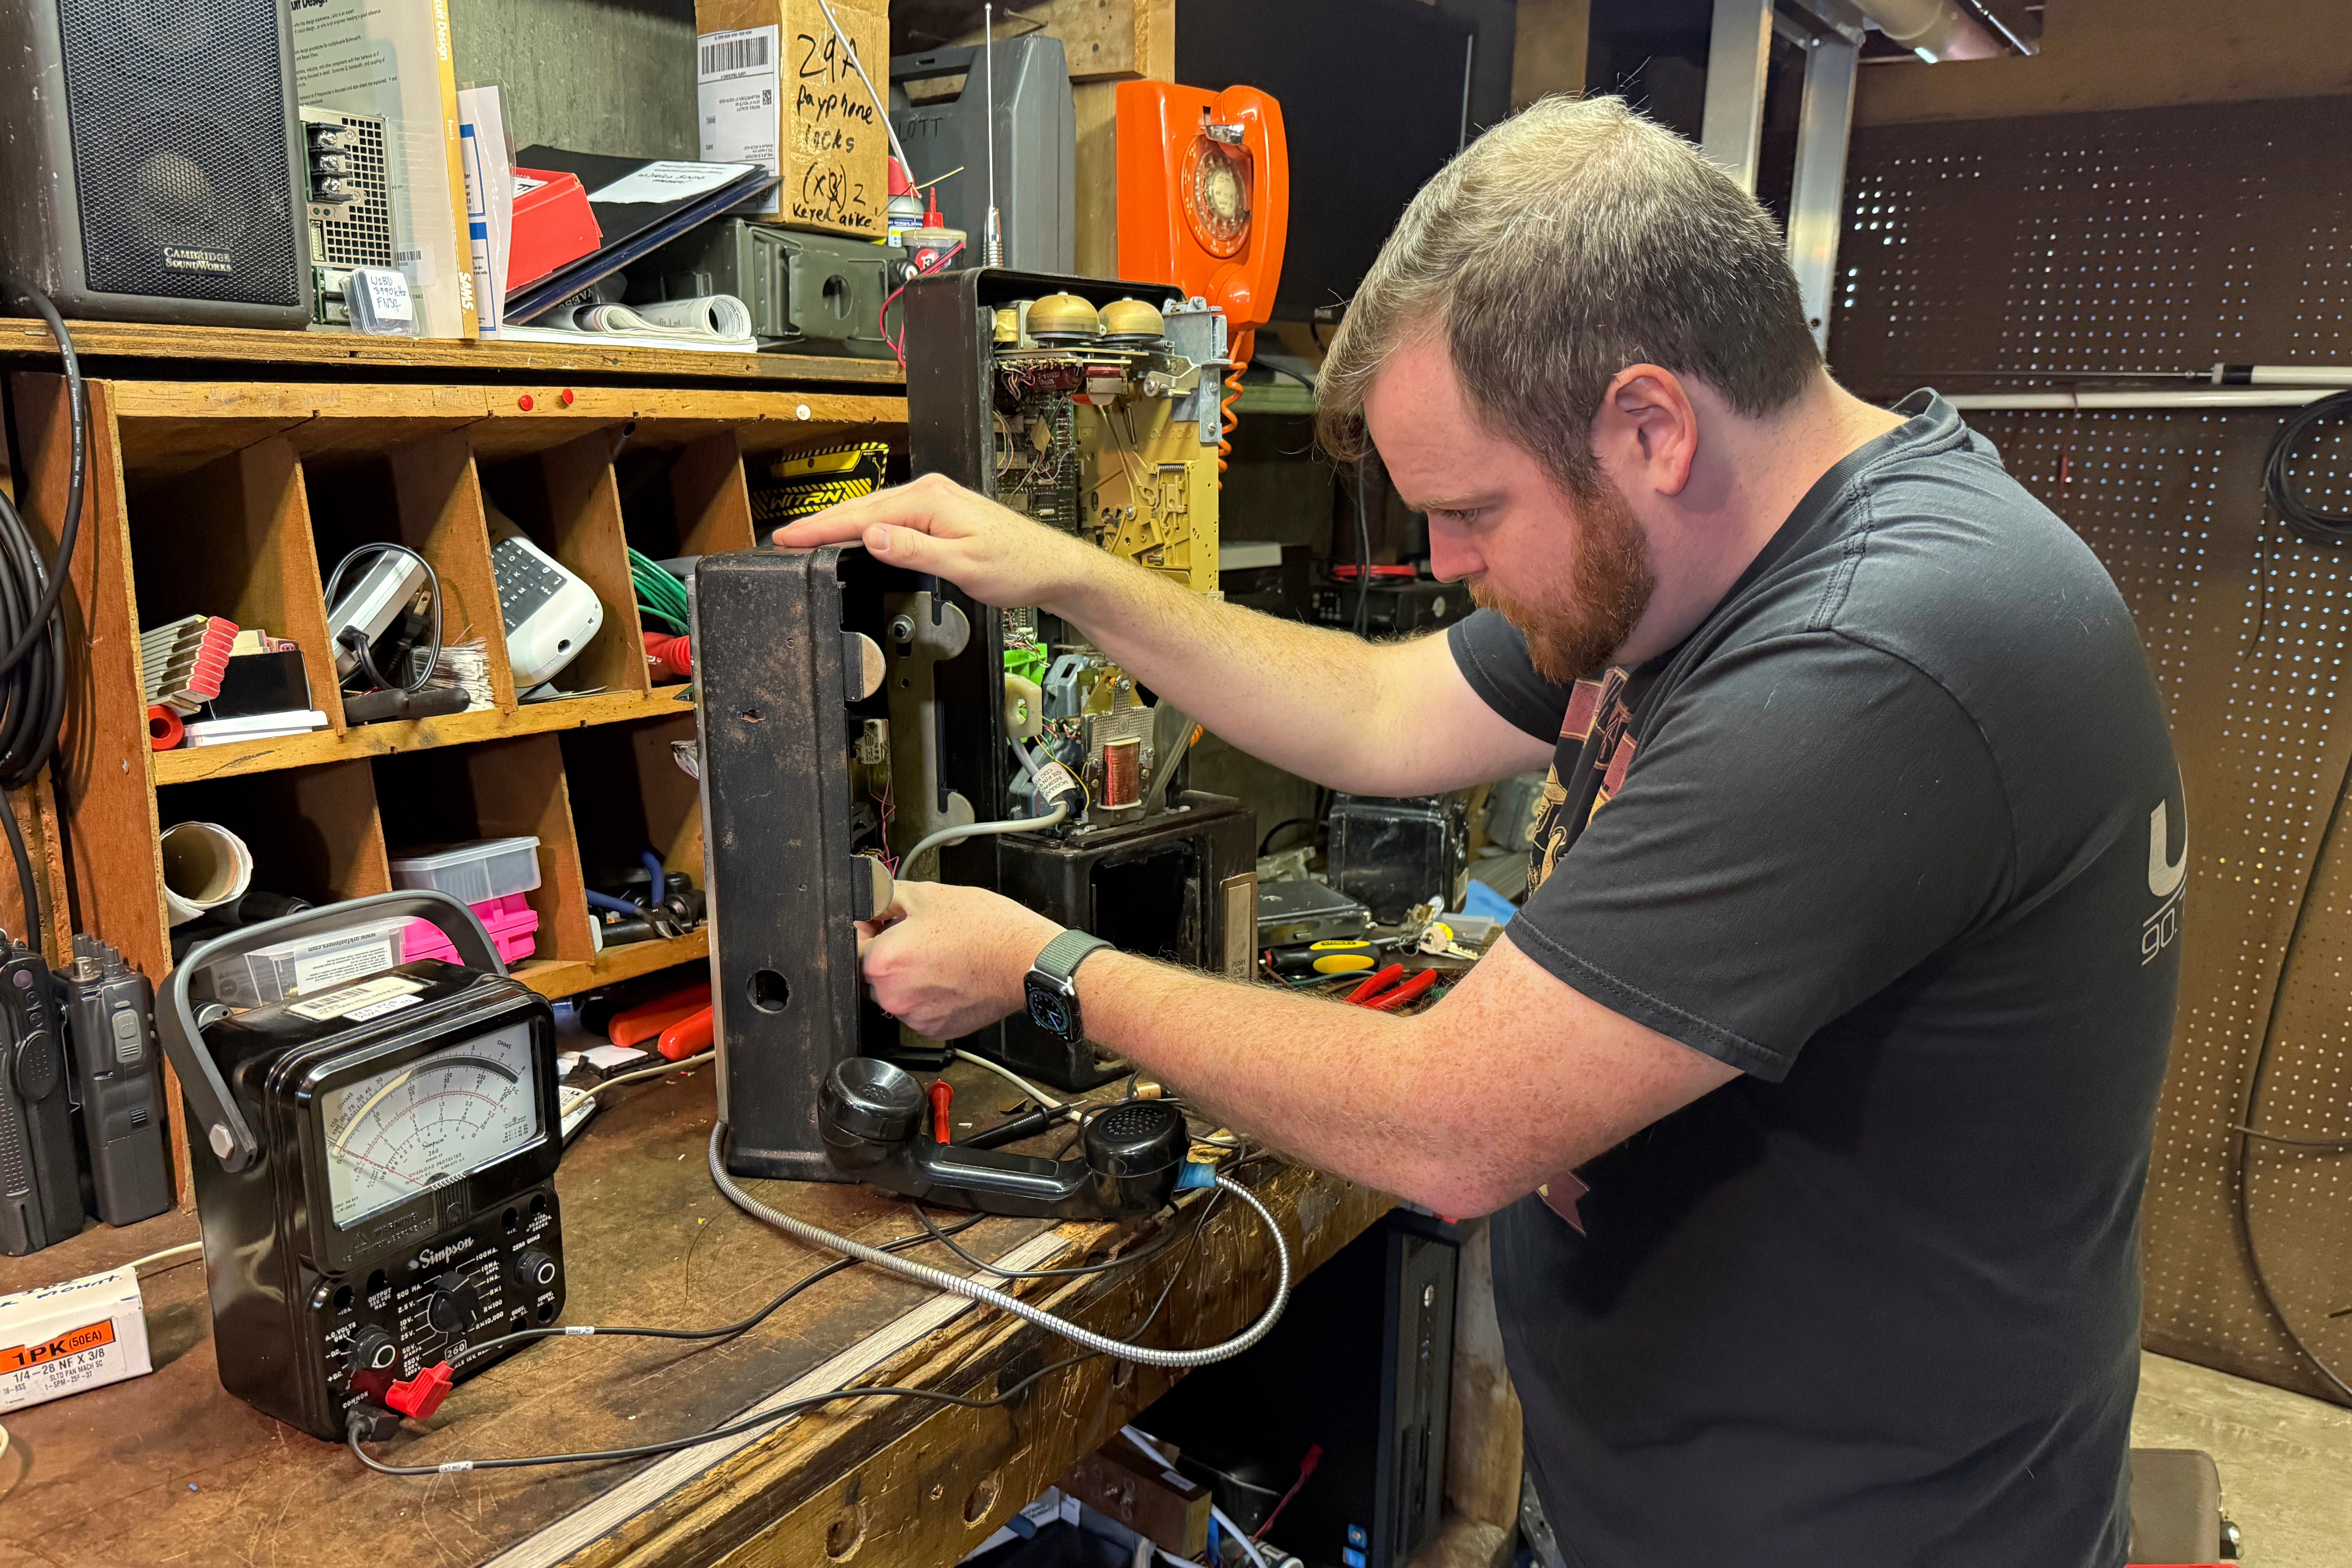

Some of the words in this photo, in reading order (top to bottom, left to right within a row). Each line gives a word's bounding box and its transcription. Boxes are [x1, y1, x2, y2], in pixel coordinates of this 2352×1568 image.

[436, 21, 448, 61] Design
[797, 34, 860, 84] 29A
[371, 276, 392, 286] W1BD
[459, 271, 474, 311] SAMS
[65, 359, 73, 376] Audio
[71, 387, 80, 422] Professional
[308, 932, 376, 952] www.arkfasteners.com
[497, 1040, 512, 1049] OHMS
[338, 1092, 353, 1110] OHMS
[422, 1138, 445, 1150] Simpson
[428, 1148, 439, 1157] 260
[408, 1164, 435, 1178] OVERLOAD
[436, 1153, 462, 1167] PROTECTED
[512, 1241, 525, 1252] ZERO
[527, 1233, 541, 1244] OHMS
[419, 1236, 475, 1269] Simpson
[368, 1286, 392, 1303] OUTPUT
[397, 1288, 409, 1300] 500
[334, 1329, 351, 1343] ONLY
[12, 1339, 68, 1366] 1PK
[69, 1330, 103, 1350] (50EA)
[446, 1343, 465, 1358] 260
[59, 1357, 73, 1371] NF
[77, 1353, 85, 1364] X
[88, 1347, 105, 1361] 3/8
[49, 1372, 64, 1382] SLTD
[65, 1367, 77, 1377] PAN
[78, 1363, 95, 1374] MACH
[96, 1359, 103, 1367] SC
[343, 1391, 369, 1409] COMMON
